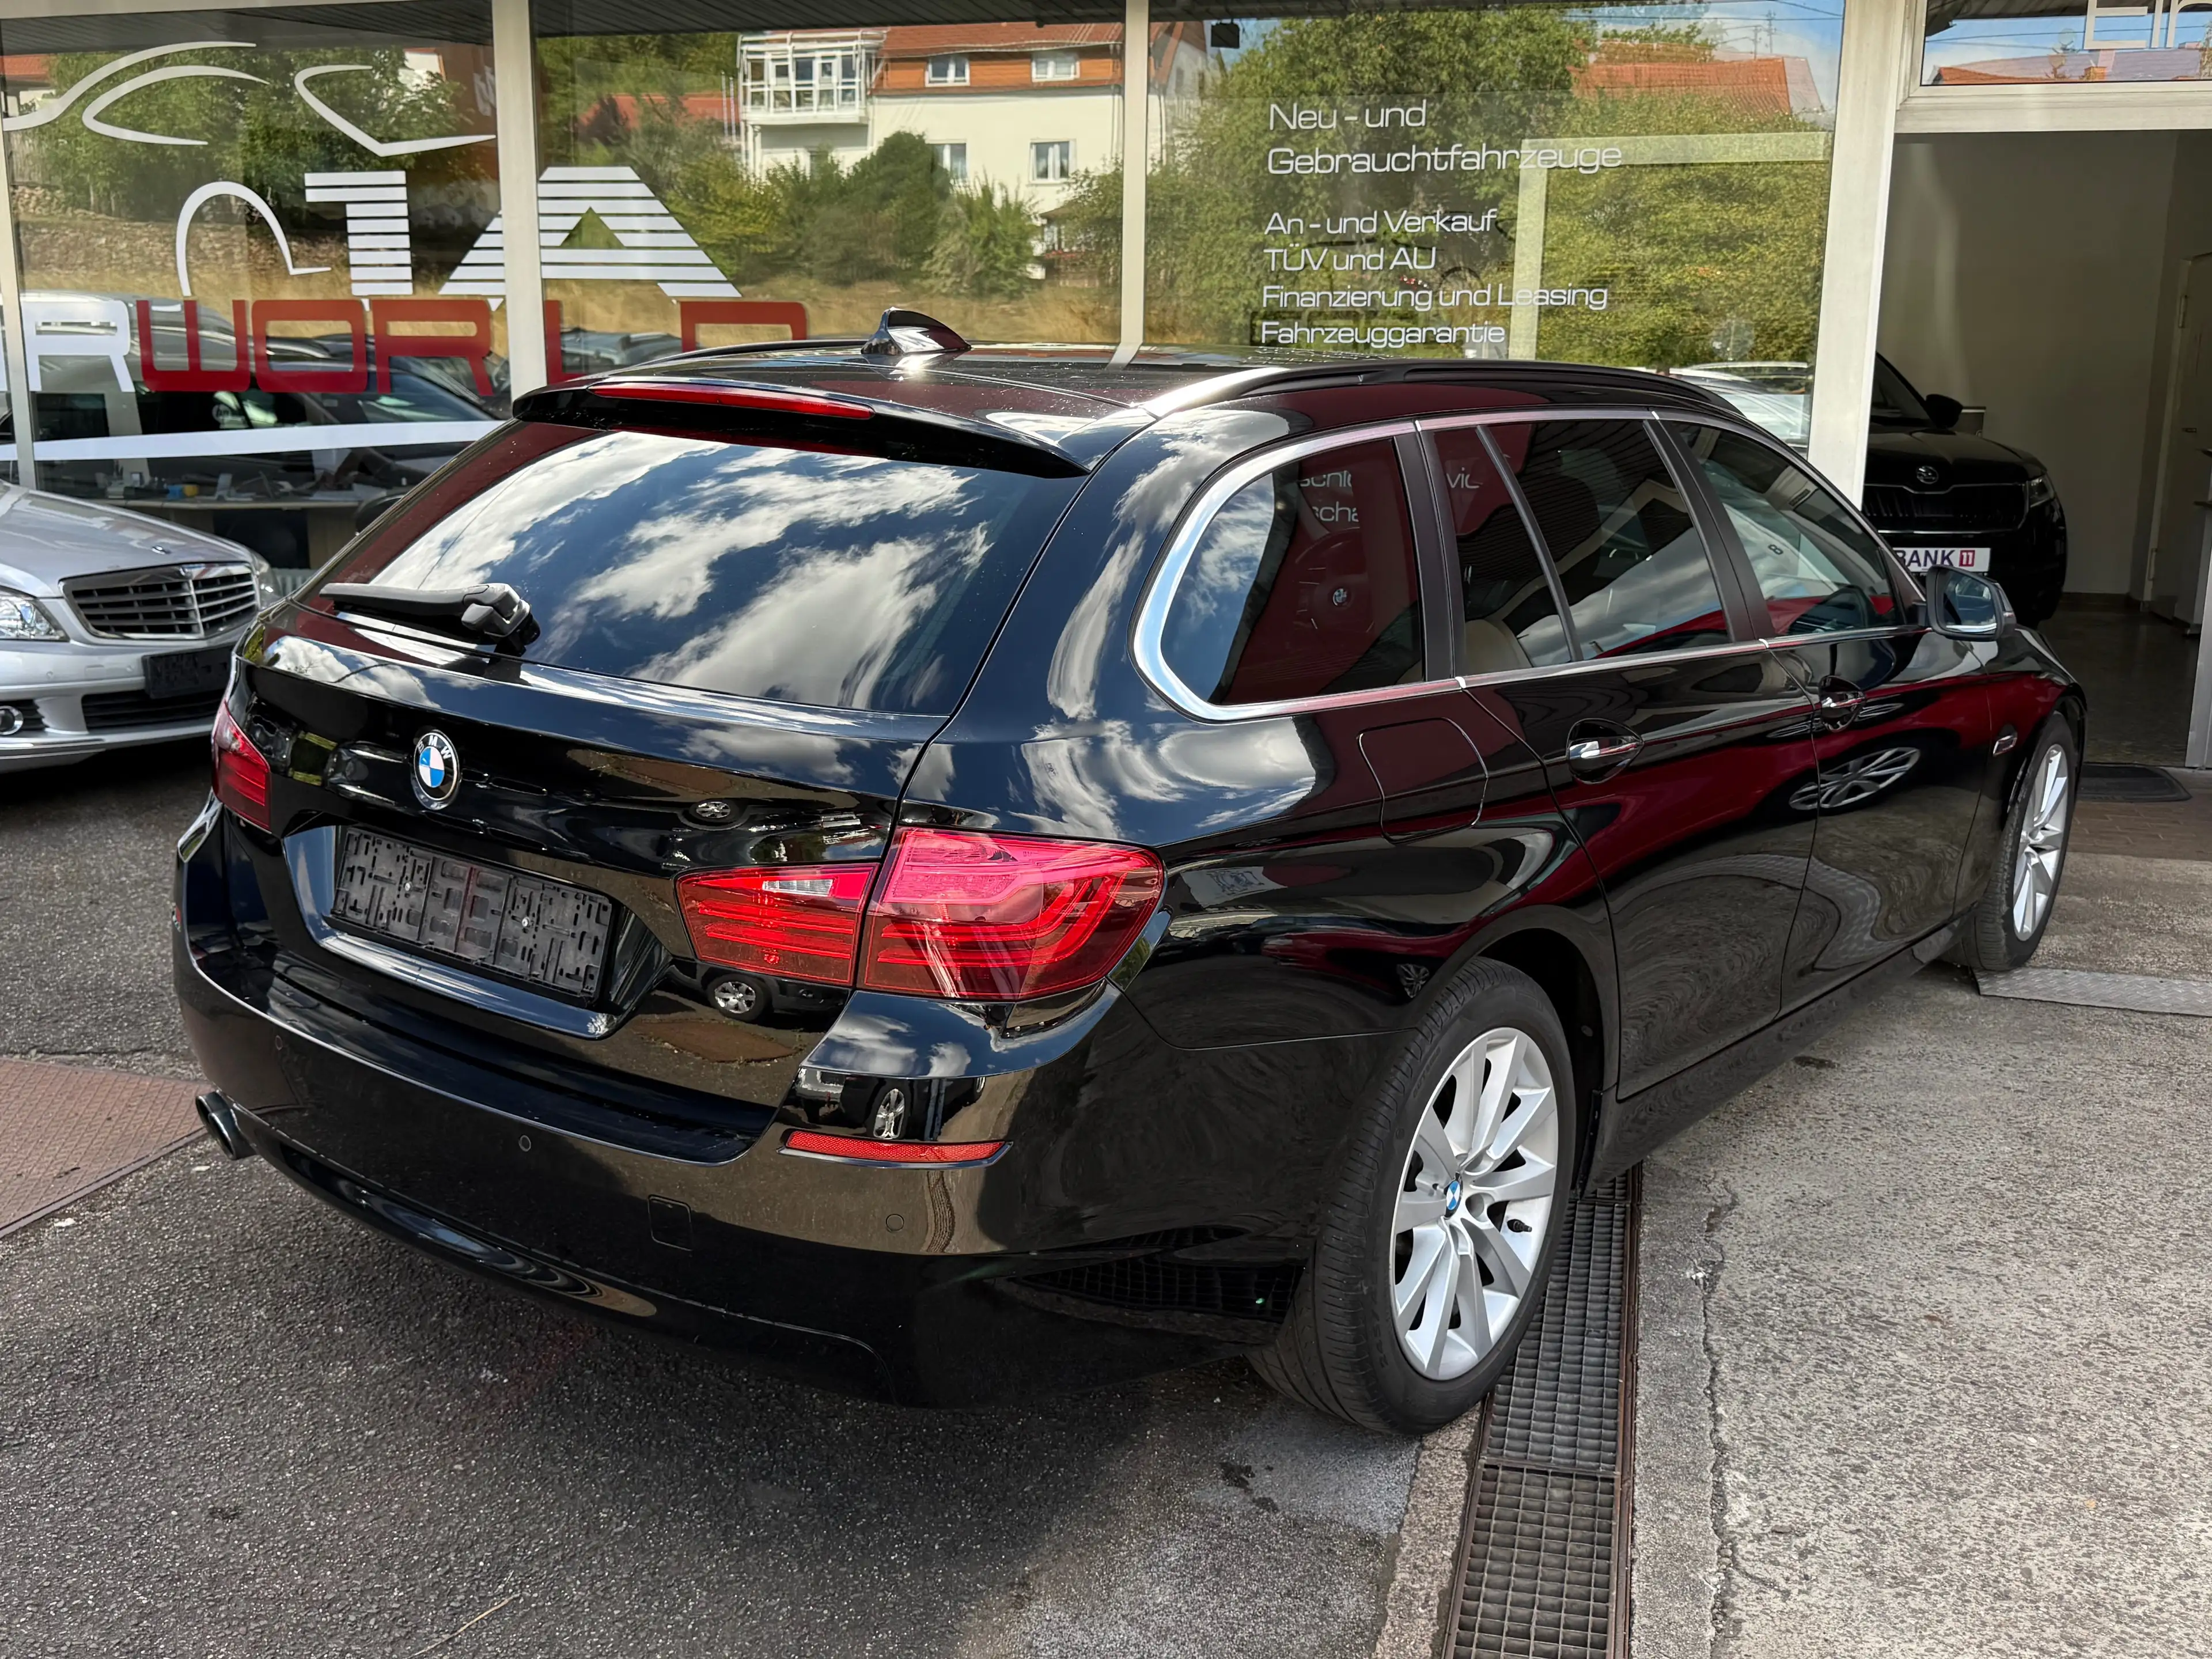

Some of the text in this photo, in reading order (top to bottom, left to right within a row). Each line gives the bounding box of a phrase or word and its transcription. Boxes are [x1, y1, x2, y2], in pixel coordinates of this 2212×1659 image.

[1269, 102, 1338, 131] Neu
[1365, 99, 1427, 128] und
[1268, 143, 1622, 175] Gebrauchtfahrzeuge
[1264, 212, 1304, 235] An
[1326, 210, 1378, 234] und
[1384, 208, 1498, 234] Verkauf
[1263, 243, 1437, 271] TÜV und AU
[1262, 282, 1608, 312] Finanzierung und Leasing
[1261, 320, 1506, 347] Fahrzeuggarantie
[418, 734, 452, 760] BMW
